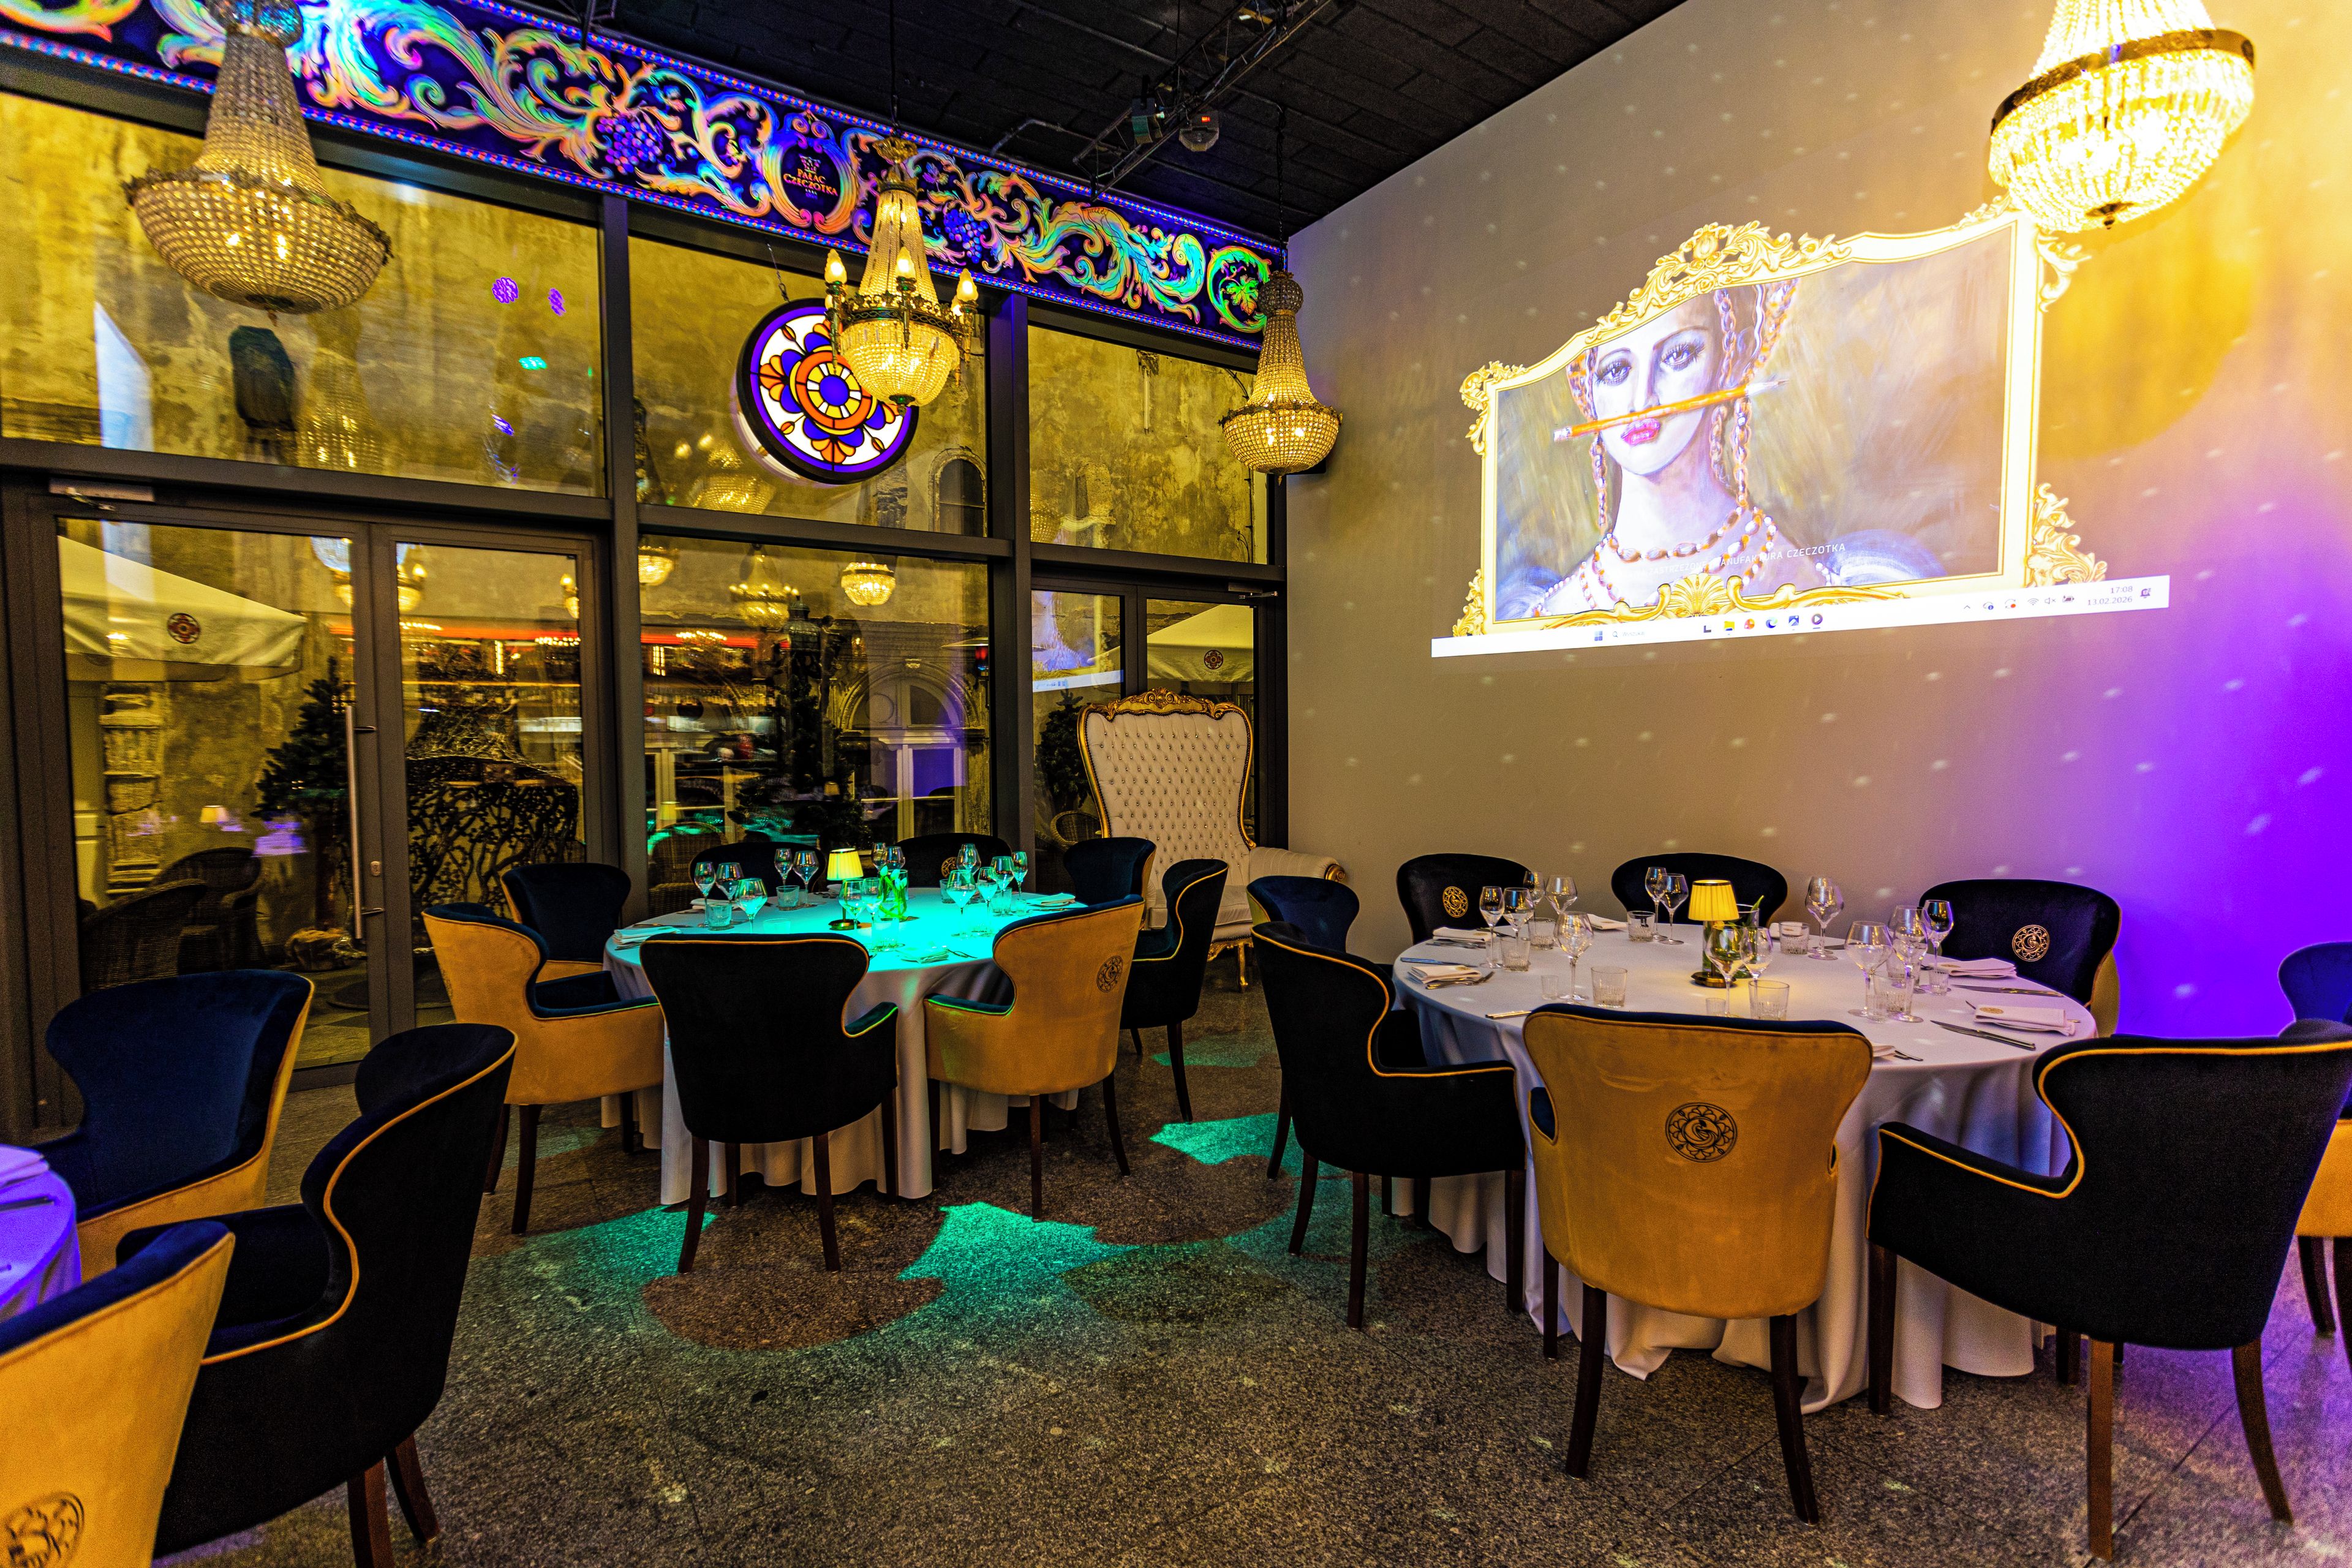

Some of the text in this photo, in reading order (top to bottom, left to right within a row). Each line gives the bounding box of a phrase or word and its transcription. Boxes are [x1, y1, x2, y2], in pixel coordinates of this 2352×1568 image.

[784, 174, 838, 196] CZECZOTKA
[1787, 543, 1845, 558] CZECZOTKA
[2088, 597, 2133, 605] 13.02.2026
